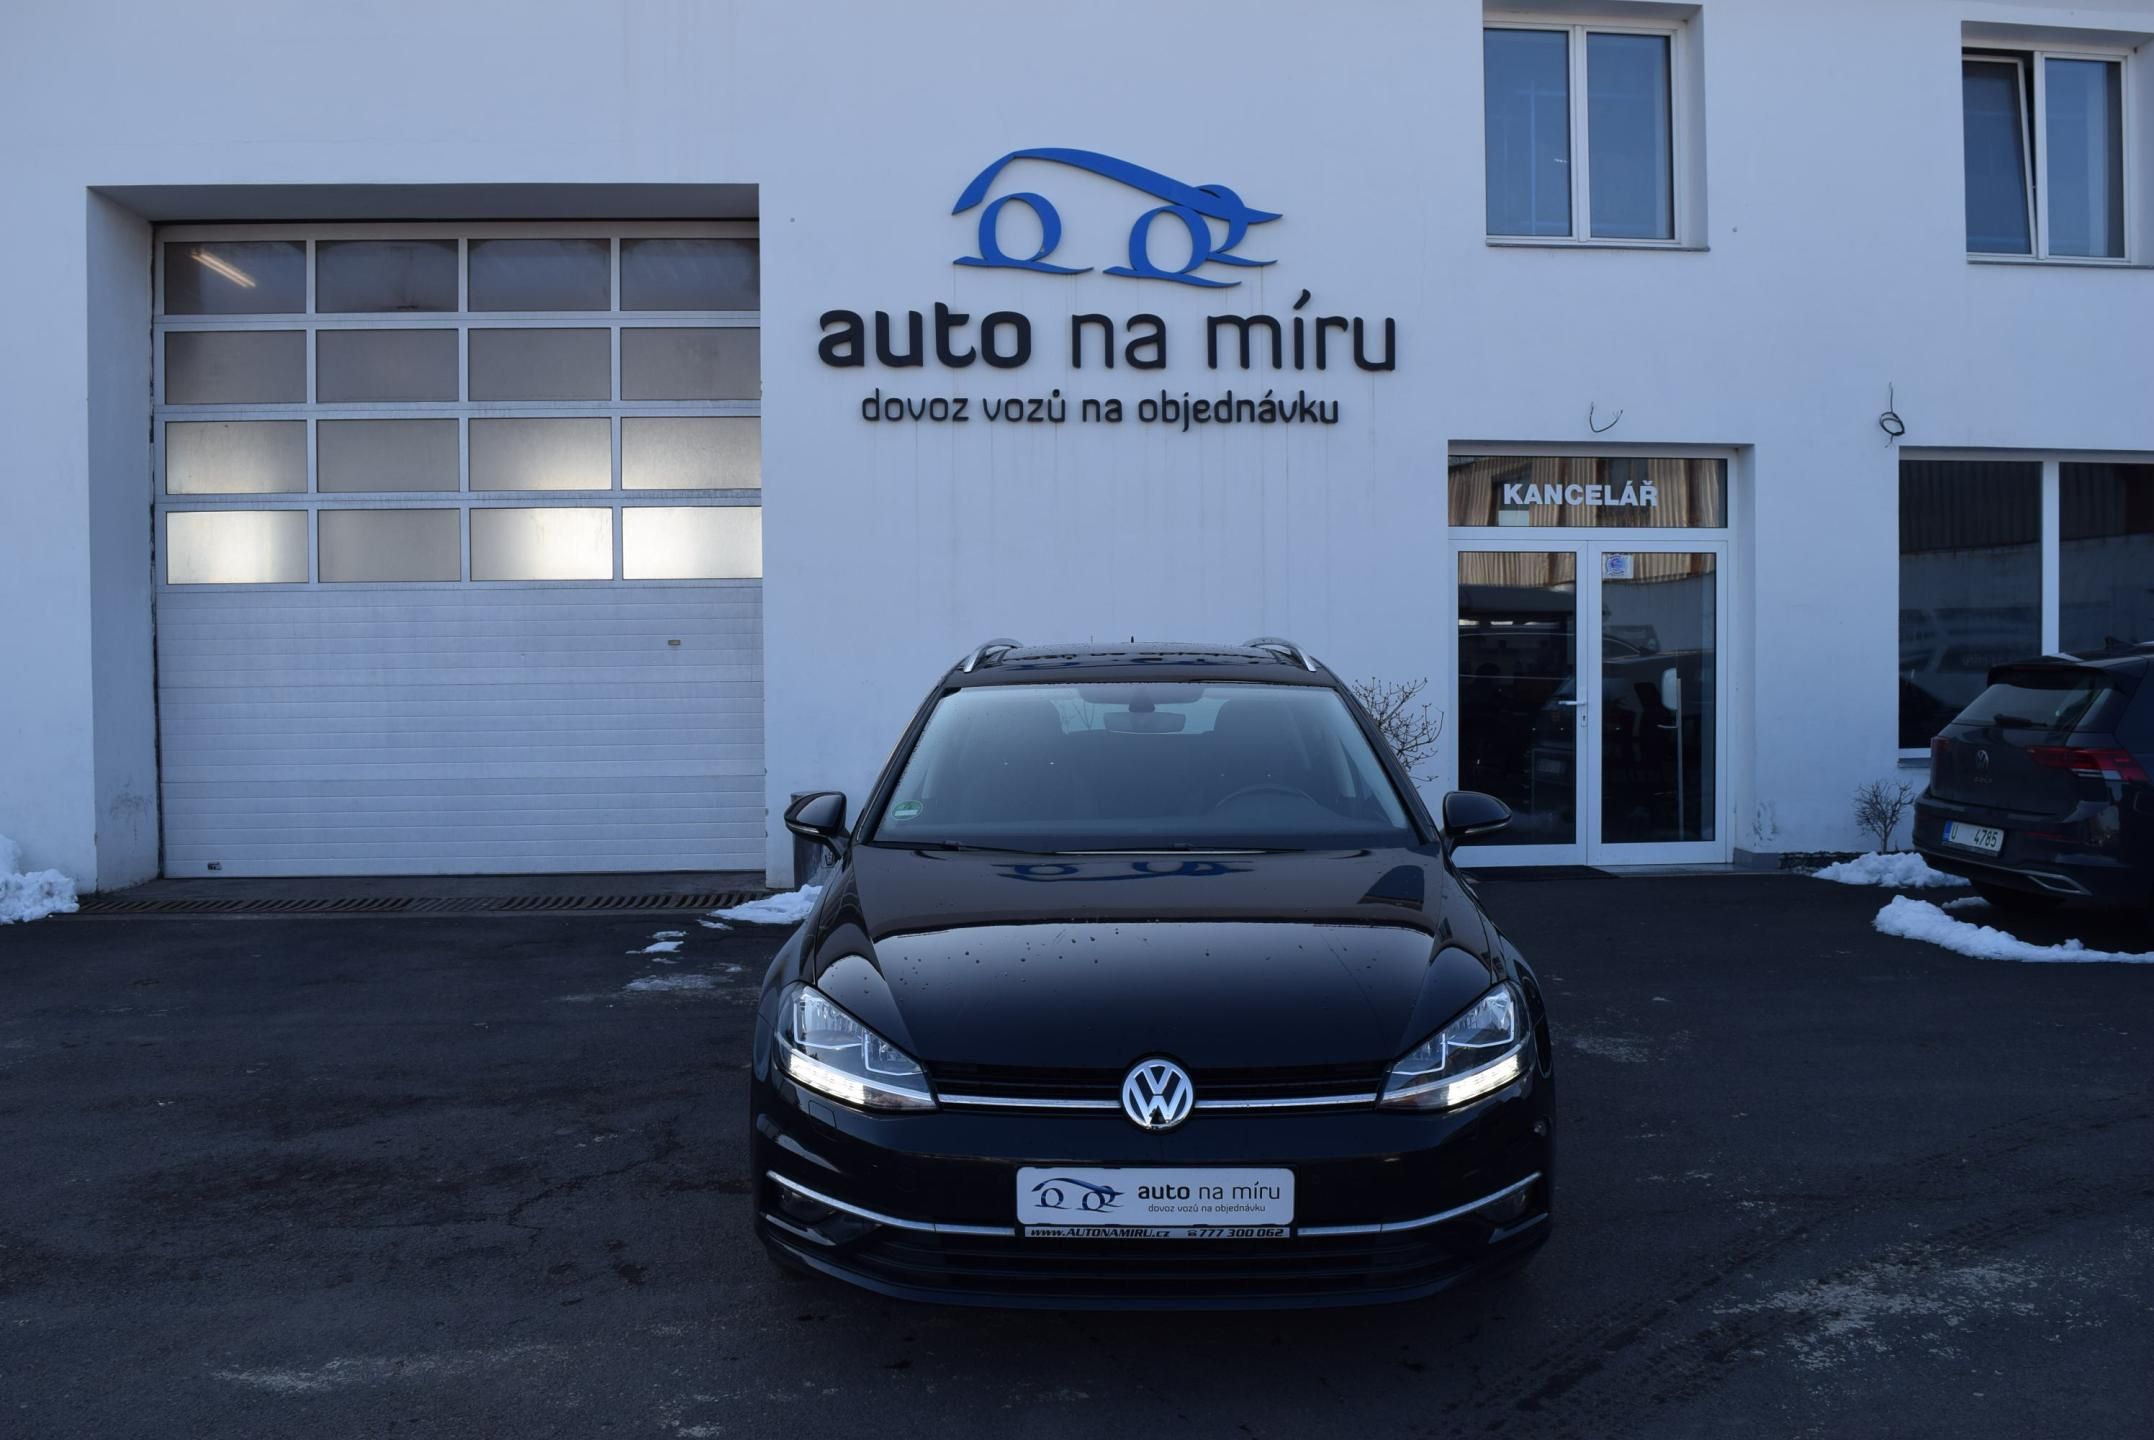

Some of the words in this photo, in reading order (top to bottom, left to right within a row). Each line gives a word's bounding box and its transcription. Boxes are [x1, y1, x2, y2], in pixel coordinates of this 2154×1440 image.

[817, 301, 1032, 370] auto
[1071, 313, 1167, 371] na
[1206, 288, 1396, 373] míru
[861, 388, 969, 424] dovoz
[982, 388, 1066, 424] vozů
[1081, 398, 1124, 424] na
[1137, 389, 1340, 433] objednávku
[1503, 480, 1659, 507] KANCELÁŘ
[1973, 828, 1998, 848] 4785
[1137, 1184, 1191, 1201] auto
[1198, 1186, 1224, 1201] na
[1232, 1180, 1281, 1201] míru
[1147, 1203, 1176, 1213] dovoz
[1177, 1203, 1199, 1213] vozů
[1201, 1205, 1213, 1213] na
[1214, 1203, 1266, 1215] objednávku
[1030, 1227, 1171, 1238] www.AUTONAMIRU.cz
[1198, 1228, 1225, 1238] 777
[1226, 1228, 1255, 1238] 300
[1256, 1228, 1285, 1238] 062
